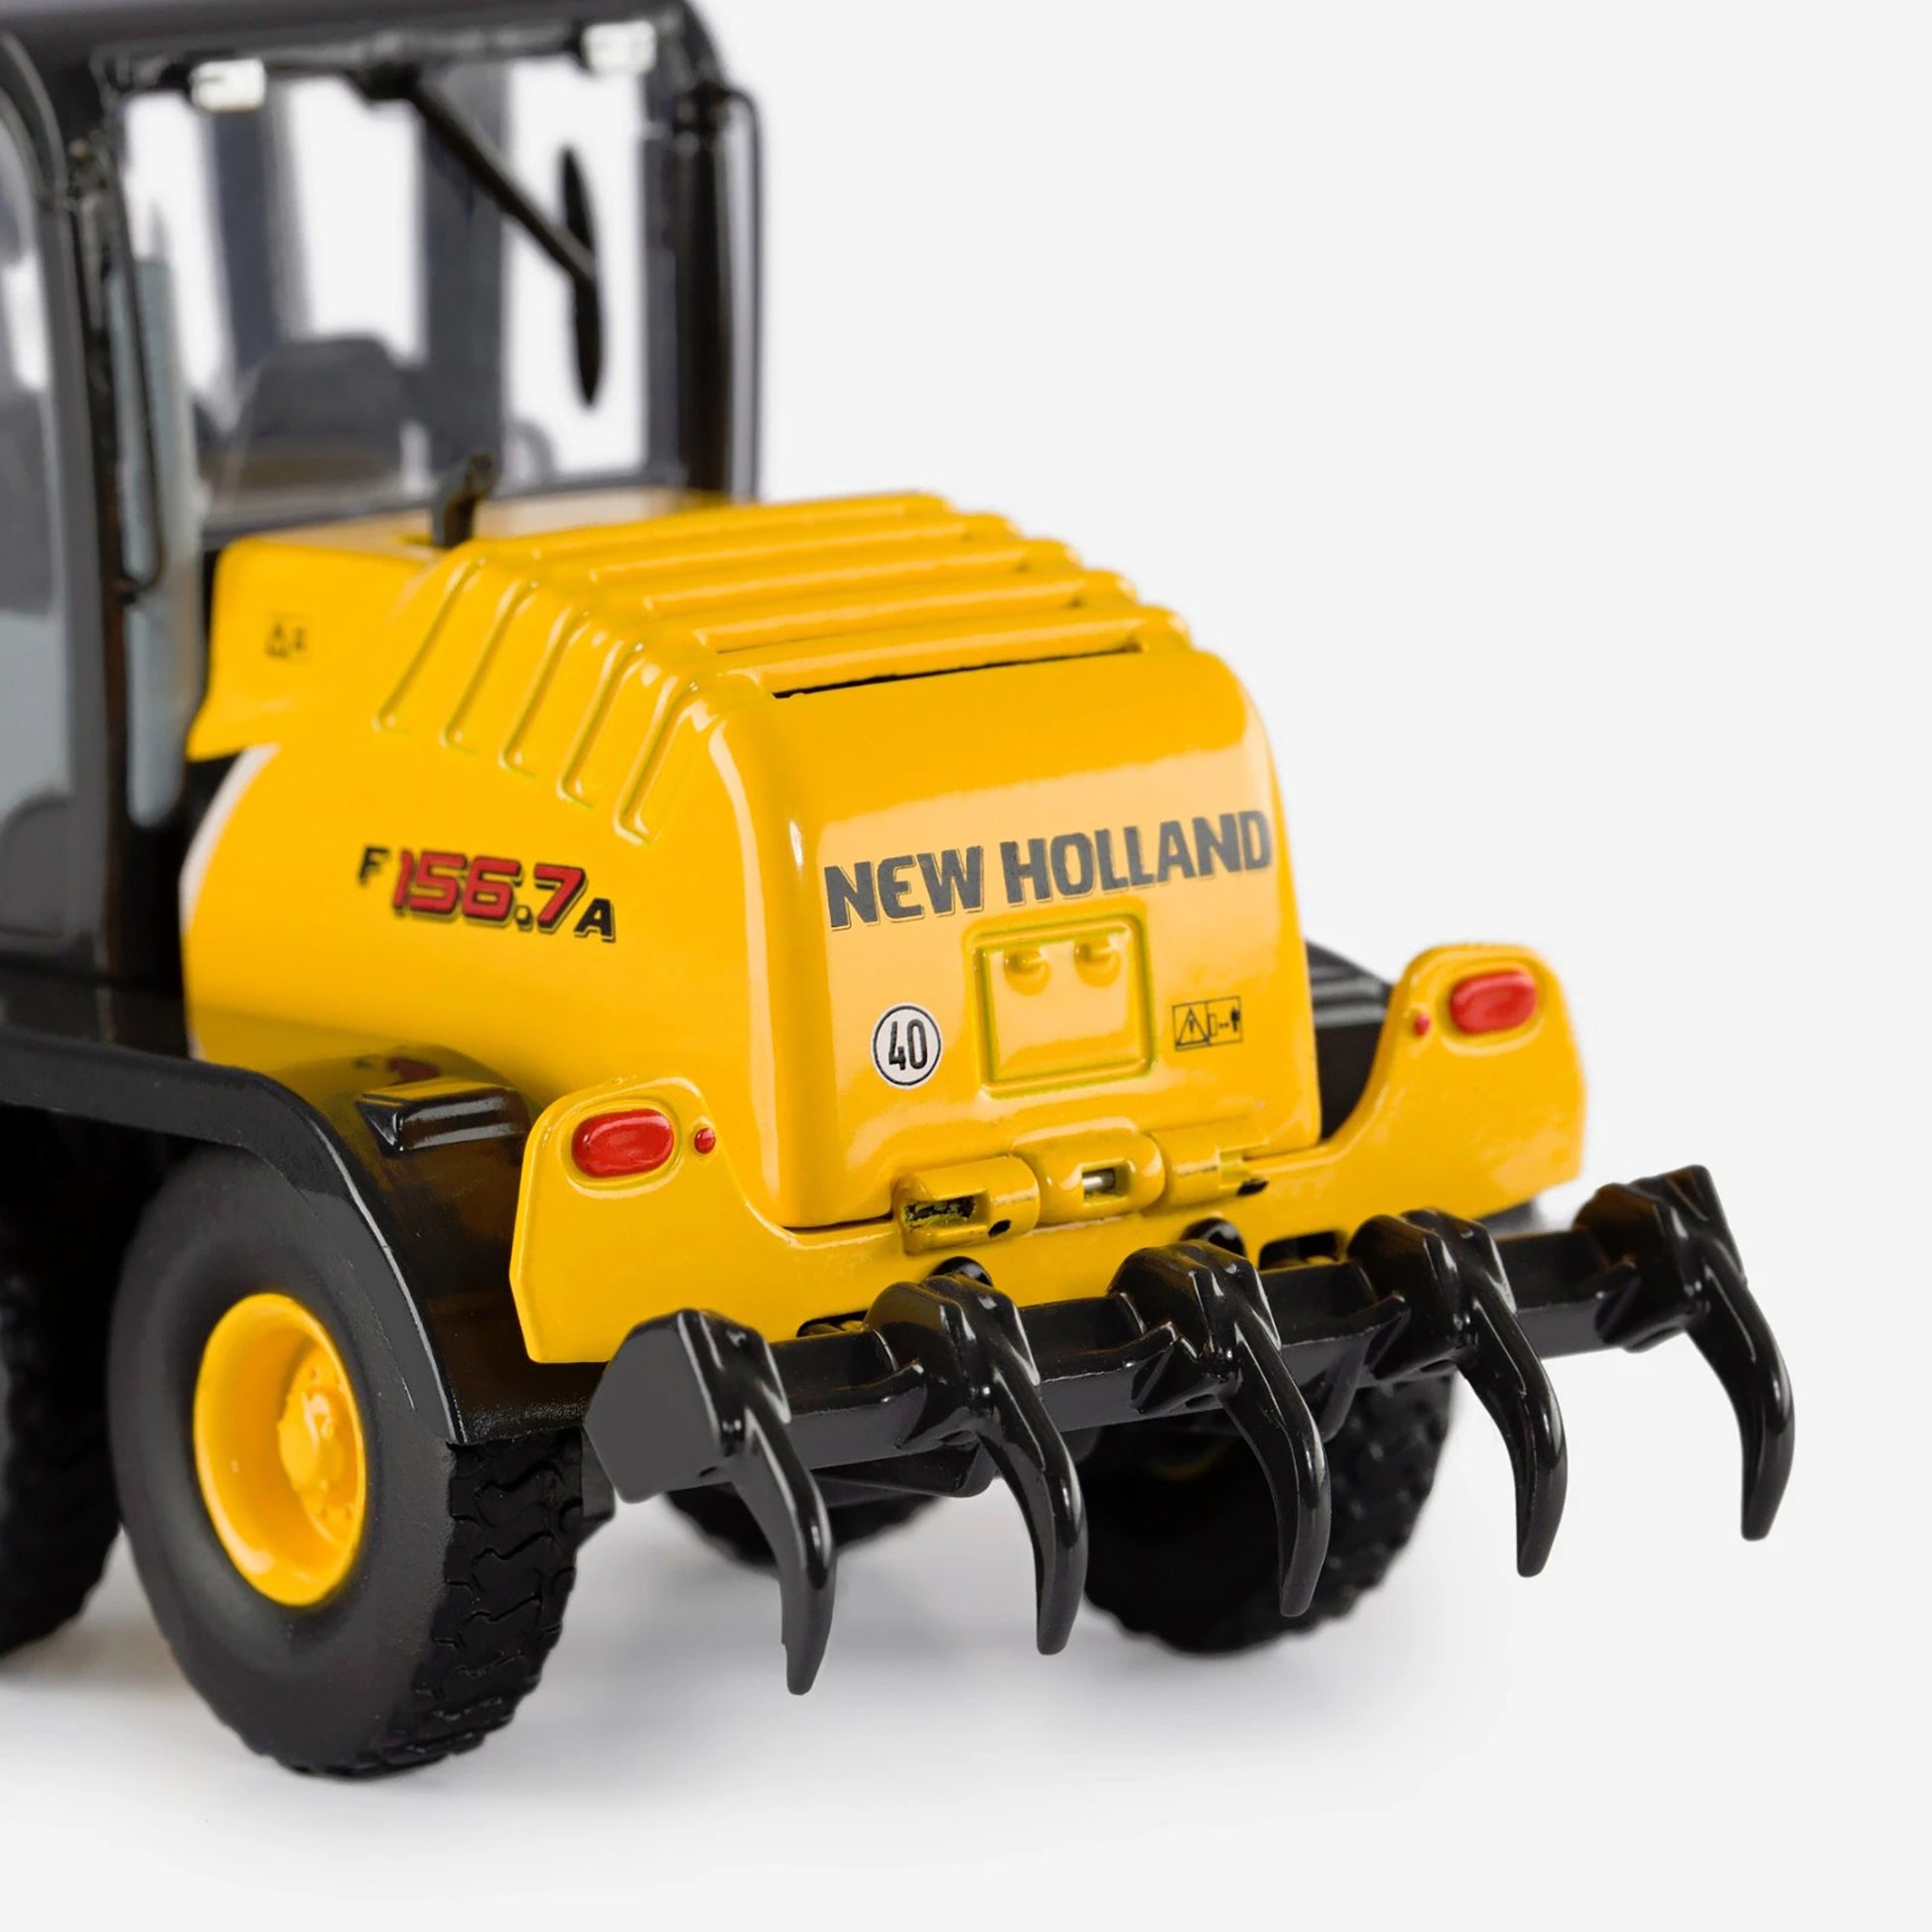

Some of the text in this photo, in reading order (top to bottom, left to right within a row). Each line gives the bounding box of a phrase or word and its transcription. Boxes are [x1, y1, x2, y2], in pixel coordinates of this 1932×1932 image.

[824, 811, 1272, 930] NEW HOLLAND
[889, 1019, 927, 1070] 40
